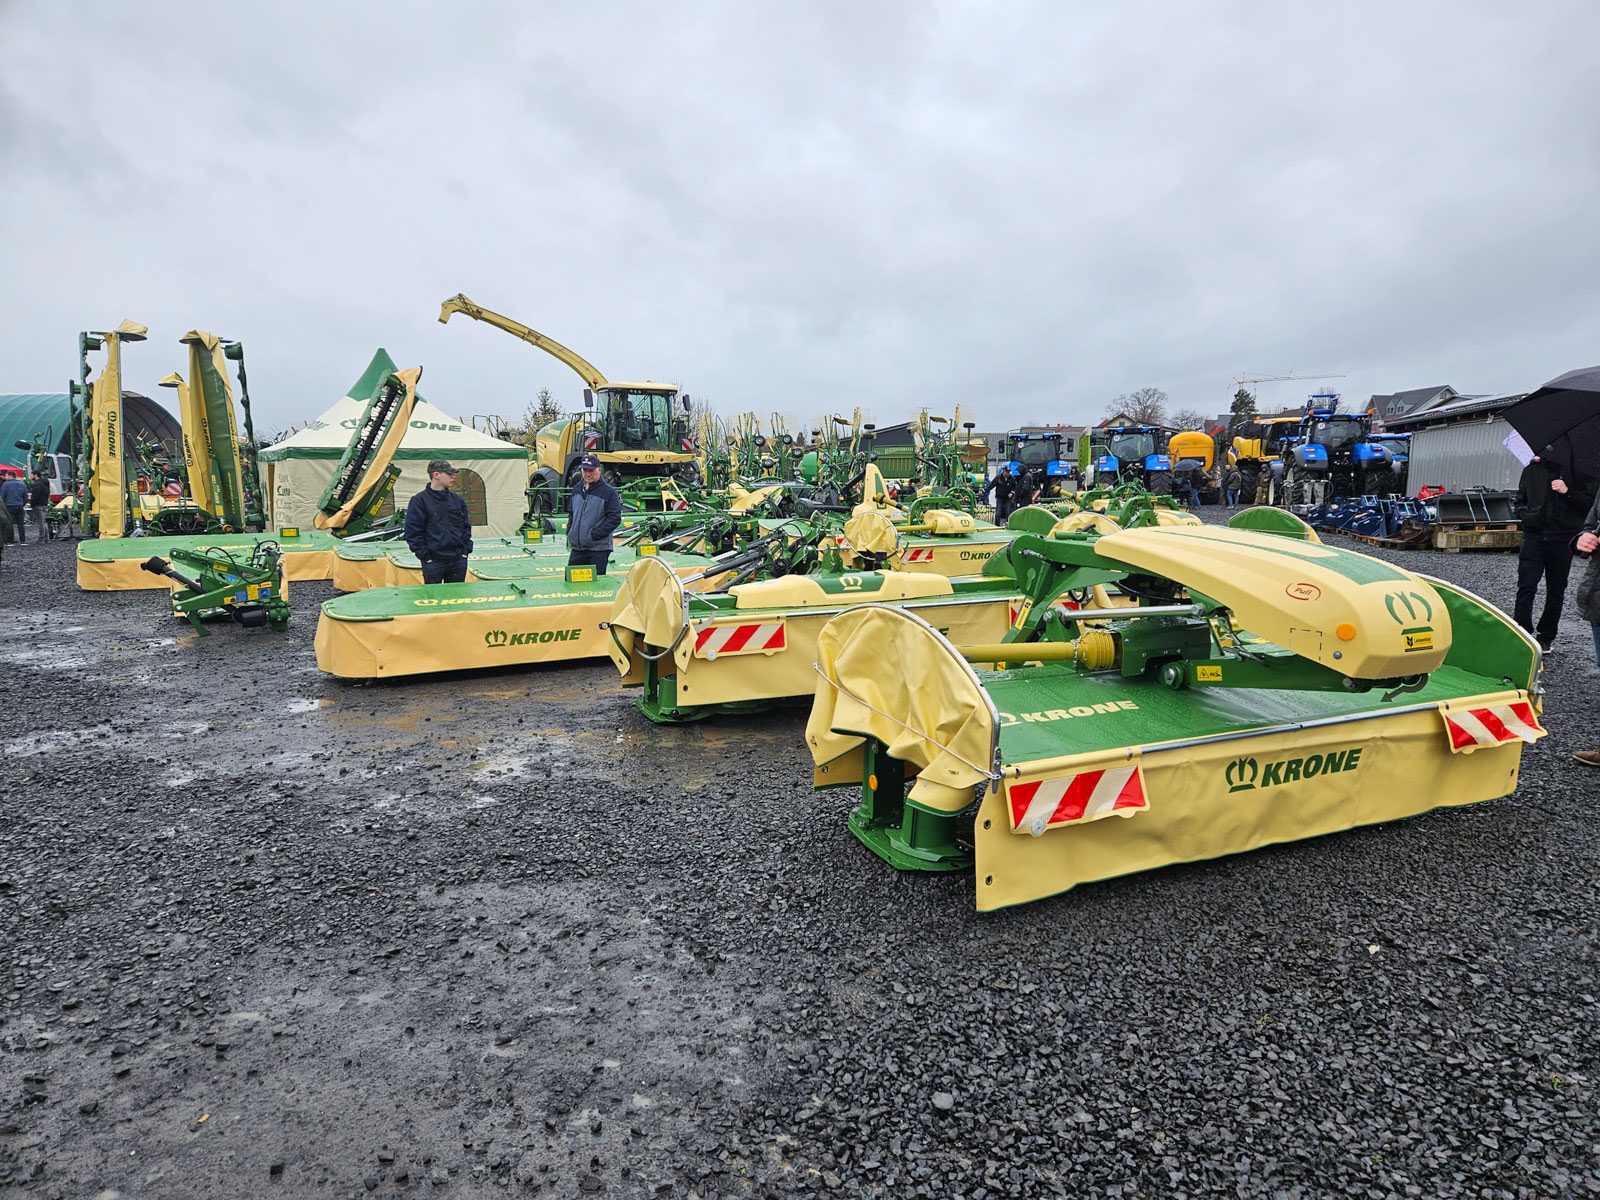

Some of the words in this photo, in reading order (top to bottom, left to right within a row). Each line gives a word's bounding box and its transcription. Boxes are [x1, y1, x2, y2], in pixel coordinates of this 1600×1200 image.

[108, 422, 116, 458] KRONE
[971, 552, 993, 561] KRO
[440, 595, 517, 606] KRONE
[1294, 587, 1313, 596] Pull
[509, 628, 582, 646] KRONE
[1020, 700, 1140, 723] KRONE
[1261, 748, 1363, 788] KRONE
